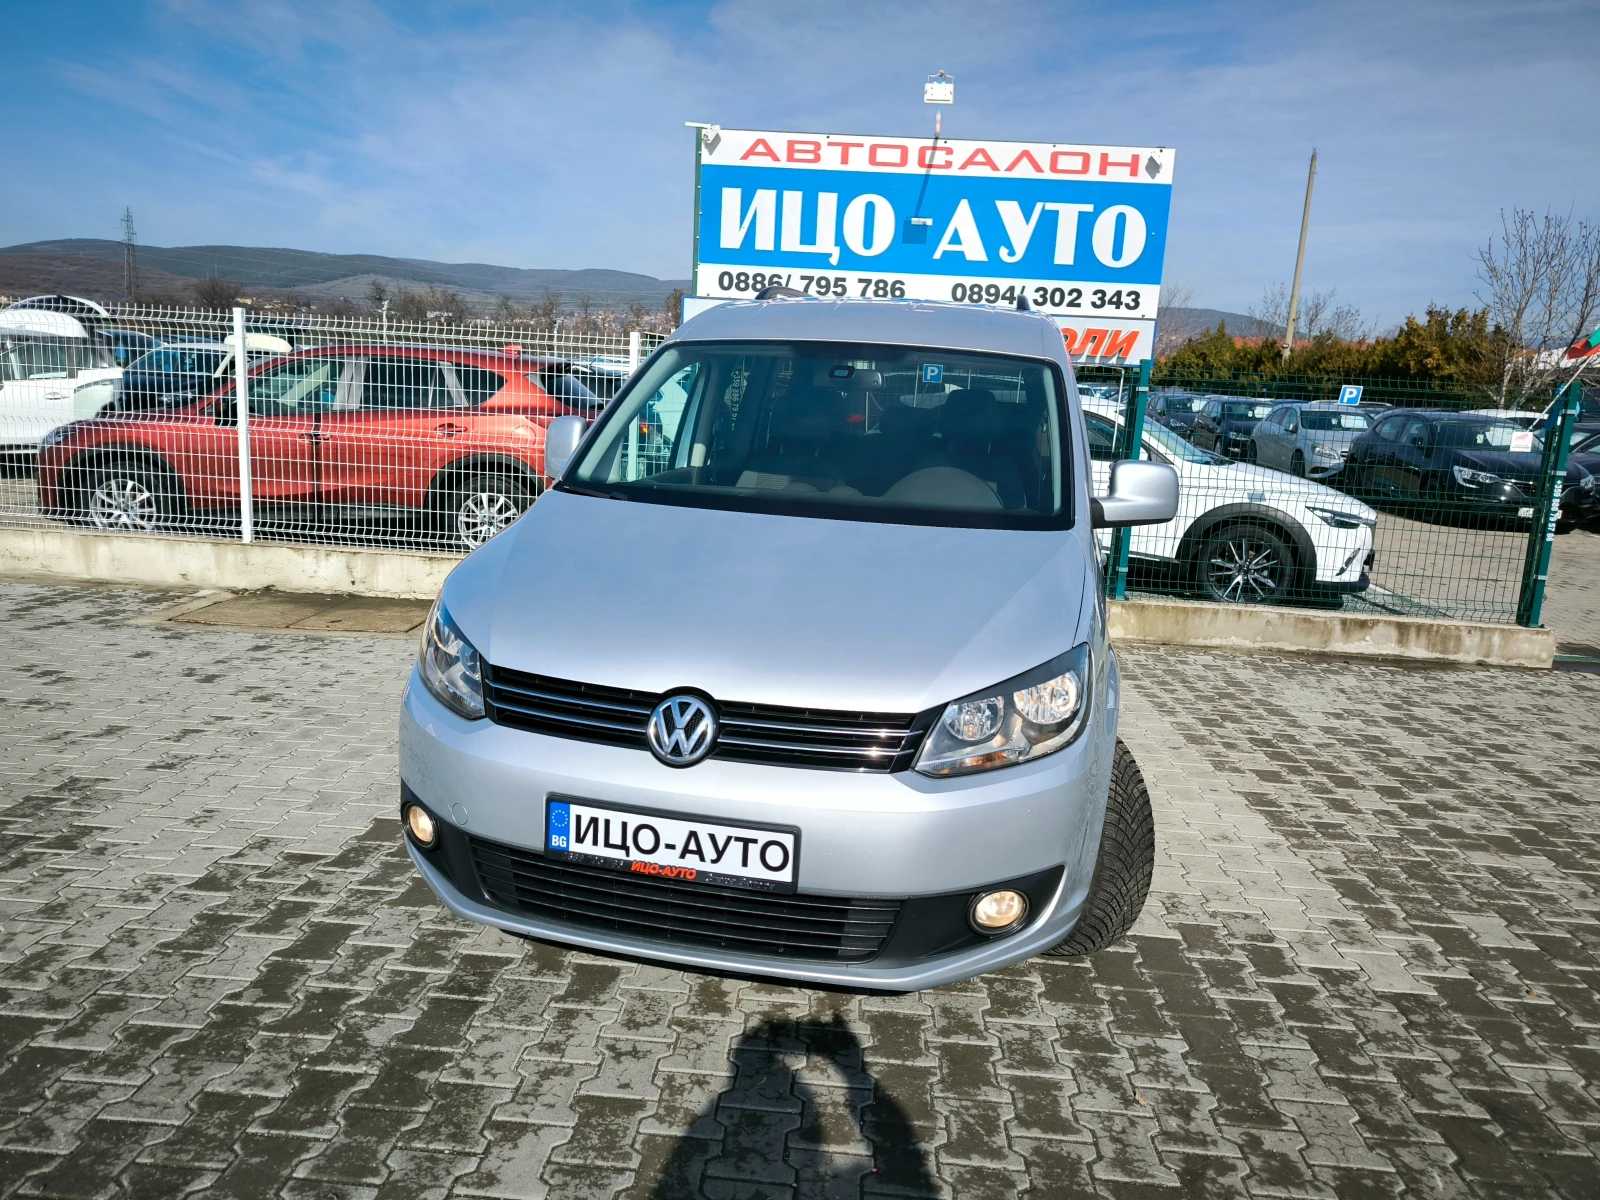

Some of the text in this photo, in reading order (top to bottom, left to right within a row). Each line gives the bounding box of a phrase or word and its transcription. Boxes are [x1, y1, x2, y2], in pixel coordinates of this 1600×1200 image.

[740, 138, 1140, 177] АВТОСАЛОН
[719, 187, 1147, 268] ИЦО АУТО
[800, 275, 847, 297] 795
[858, 278, 906, 299] 786
[1033, 287, 1083, 307] 302
[1091, 289, 1141, 310] 343
[1060, 328, 1140, 358] ОЛИ
[927, 367, 938, 380] P
[1343, 388, 1357, 403] P
[1546, 480, 1562, 542] +359 886 79 57 86
[650, 696, 715, 762] VW
[551, 834, 567, 848] BG
[575, 814, 790, 872] ИЦО-АУТО
[631, 860, 697, 880] ИЦО-АУТО
